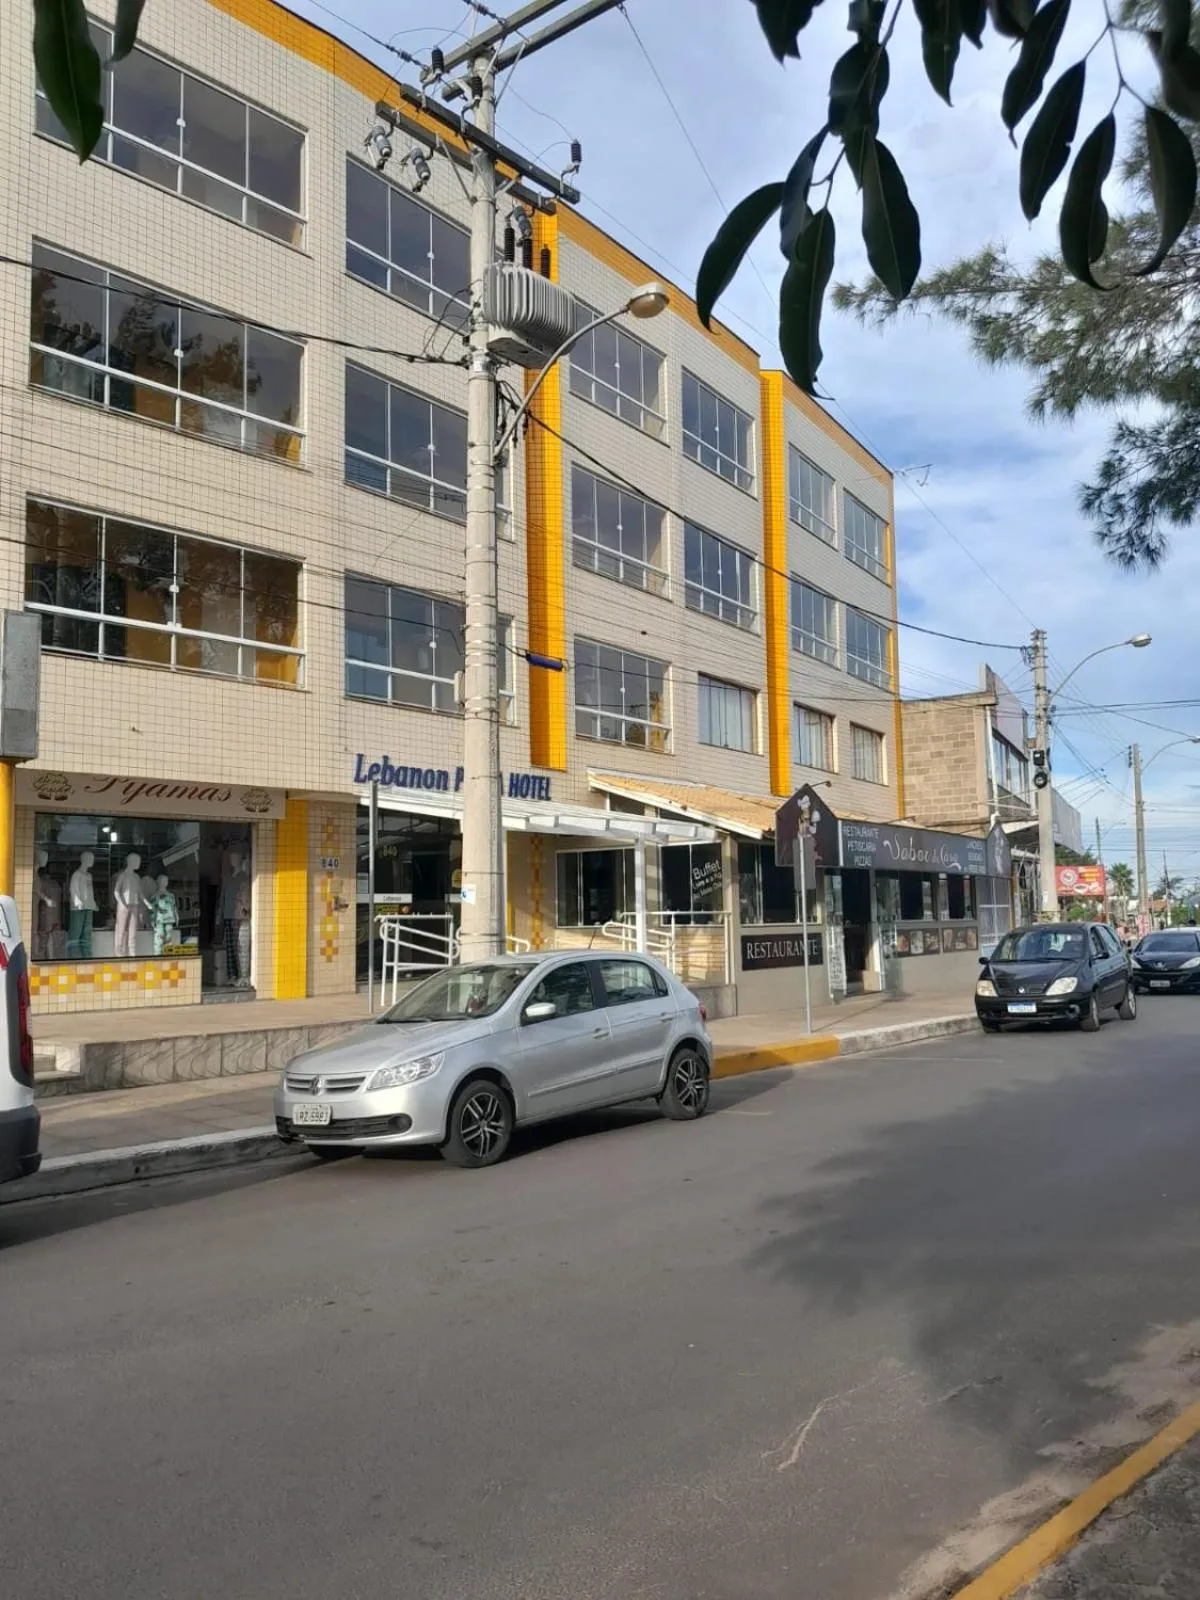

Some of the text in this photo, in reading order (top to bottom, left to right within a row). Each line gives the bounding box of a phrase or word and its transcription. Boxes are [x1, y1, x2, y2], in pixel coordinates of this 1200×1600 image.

[353, 753, 449, 791] Lebanon
[508, 772, 552, 801] HOTEL
[692, 859, 721, 880] Buffet
[746, 939, 819, 960] RESTAURANTE
